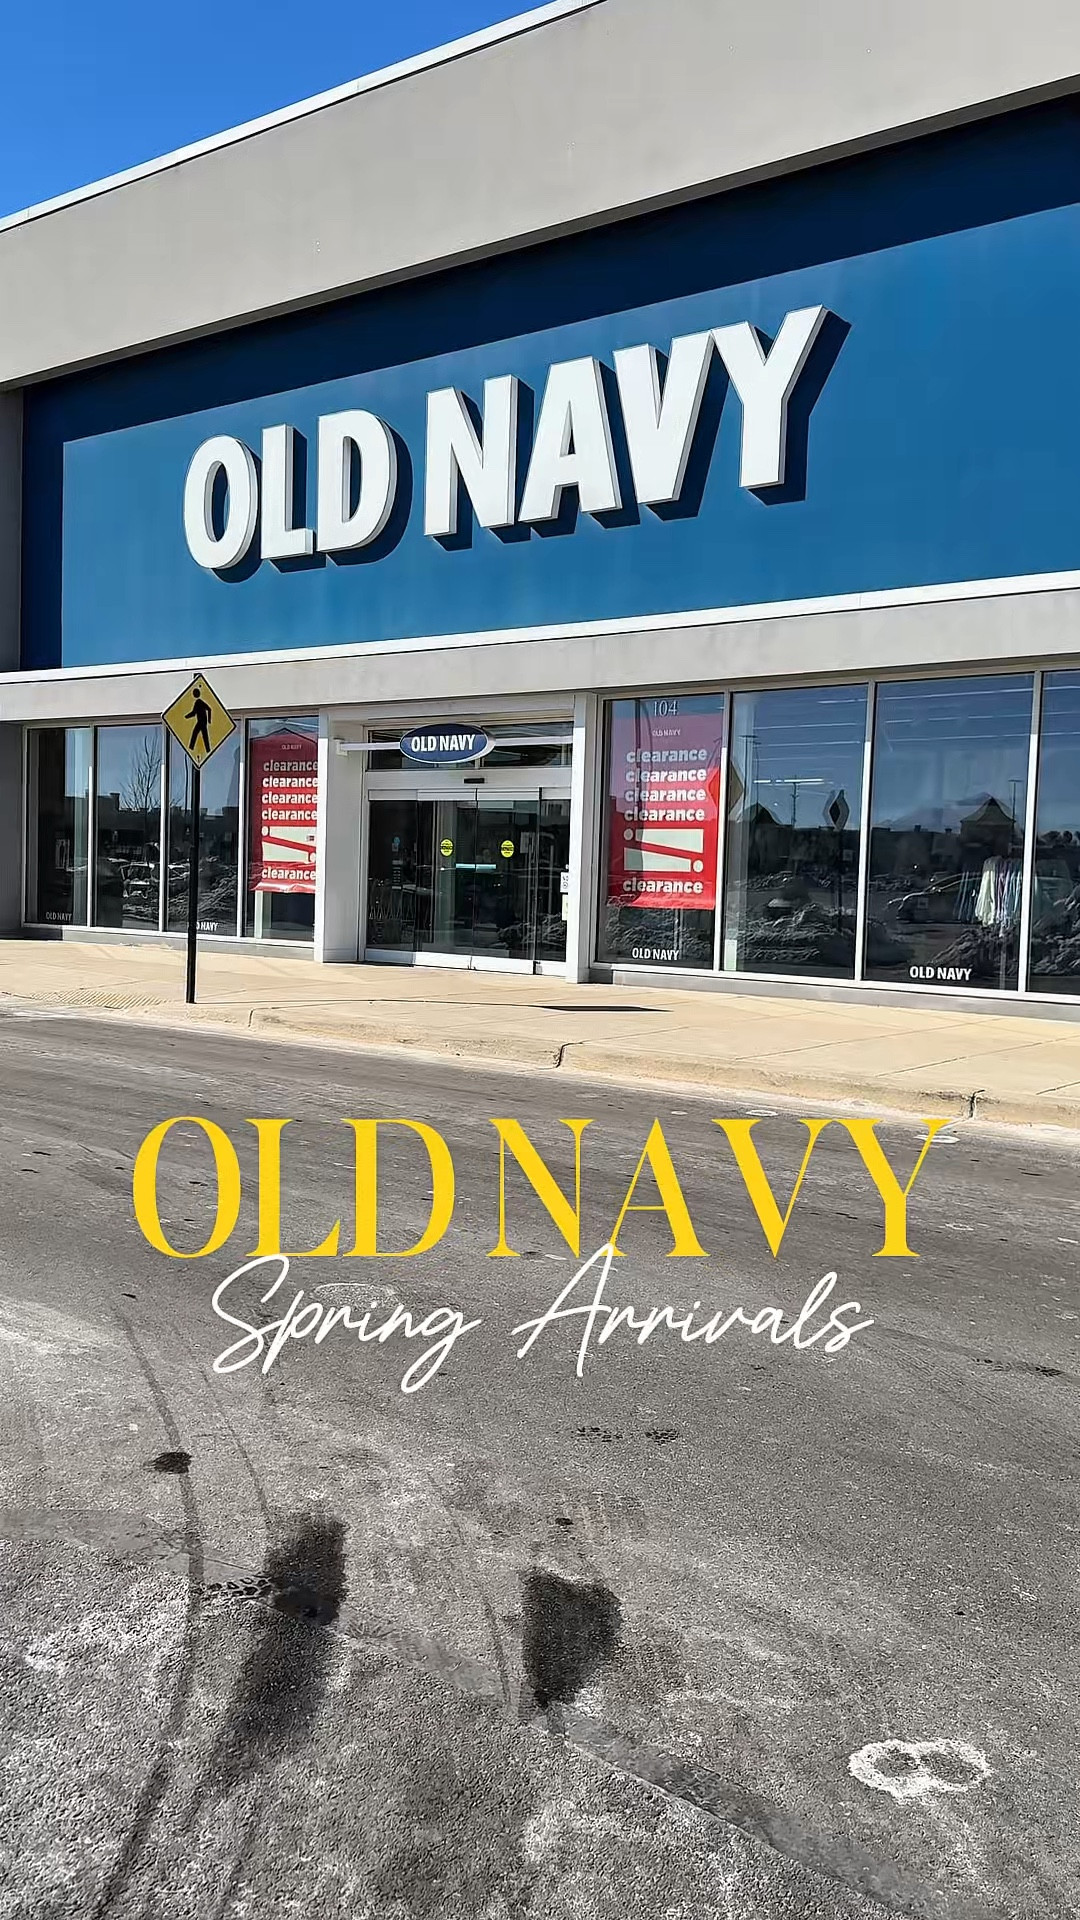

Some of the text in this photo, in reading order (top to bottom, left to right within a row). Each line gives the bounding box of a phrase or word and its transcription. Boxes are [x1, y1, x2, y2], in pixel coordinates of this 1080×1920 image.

[183, 304, 830, 570] OLD NAVY
[653, 699, 678, 717] 104
[410, 733, 476, 752] OLD NAVY
[626, 748, 708, 763] clearance
[263, 759, 319, 772] clearance
[262, 775, 319, 788] clearance
[625, 768, 707, 783] clearance
[261, 792, 318, 804] clearance
[624, 787, 707, 802] clearance
[261, 807, 318, 821] clearance
[624, 806, 706, 822] clearance
[261, 866, 317, 881] clearance
[622, 877, 704, 894] clearance
[632, 947, 680, 961] OLD NAVY
[909, 965, 972, 981] OLD NAVY
